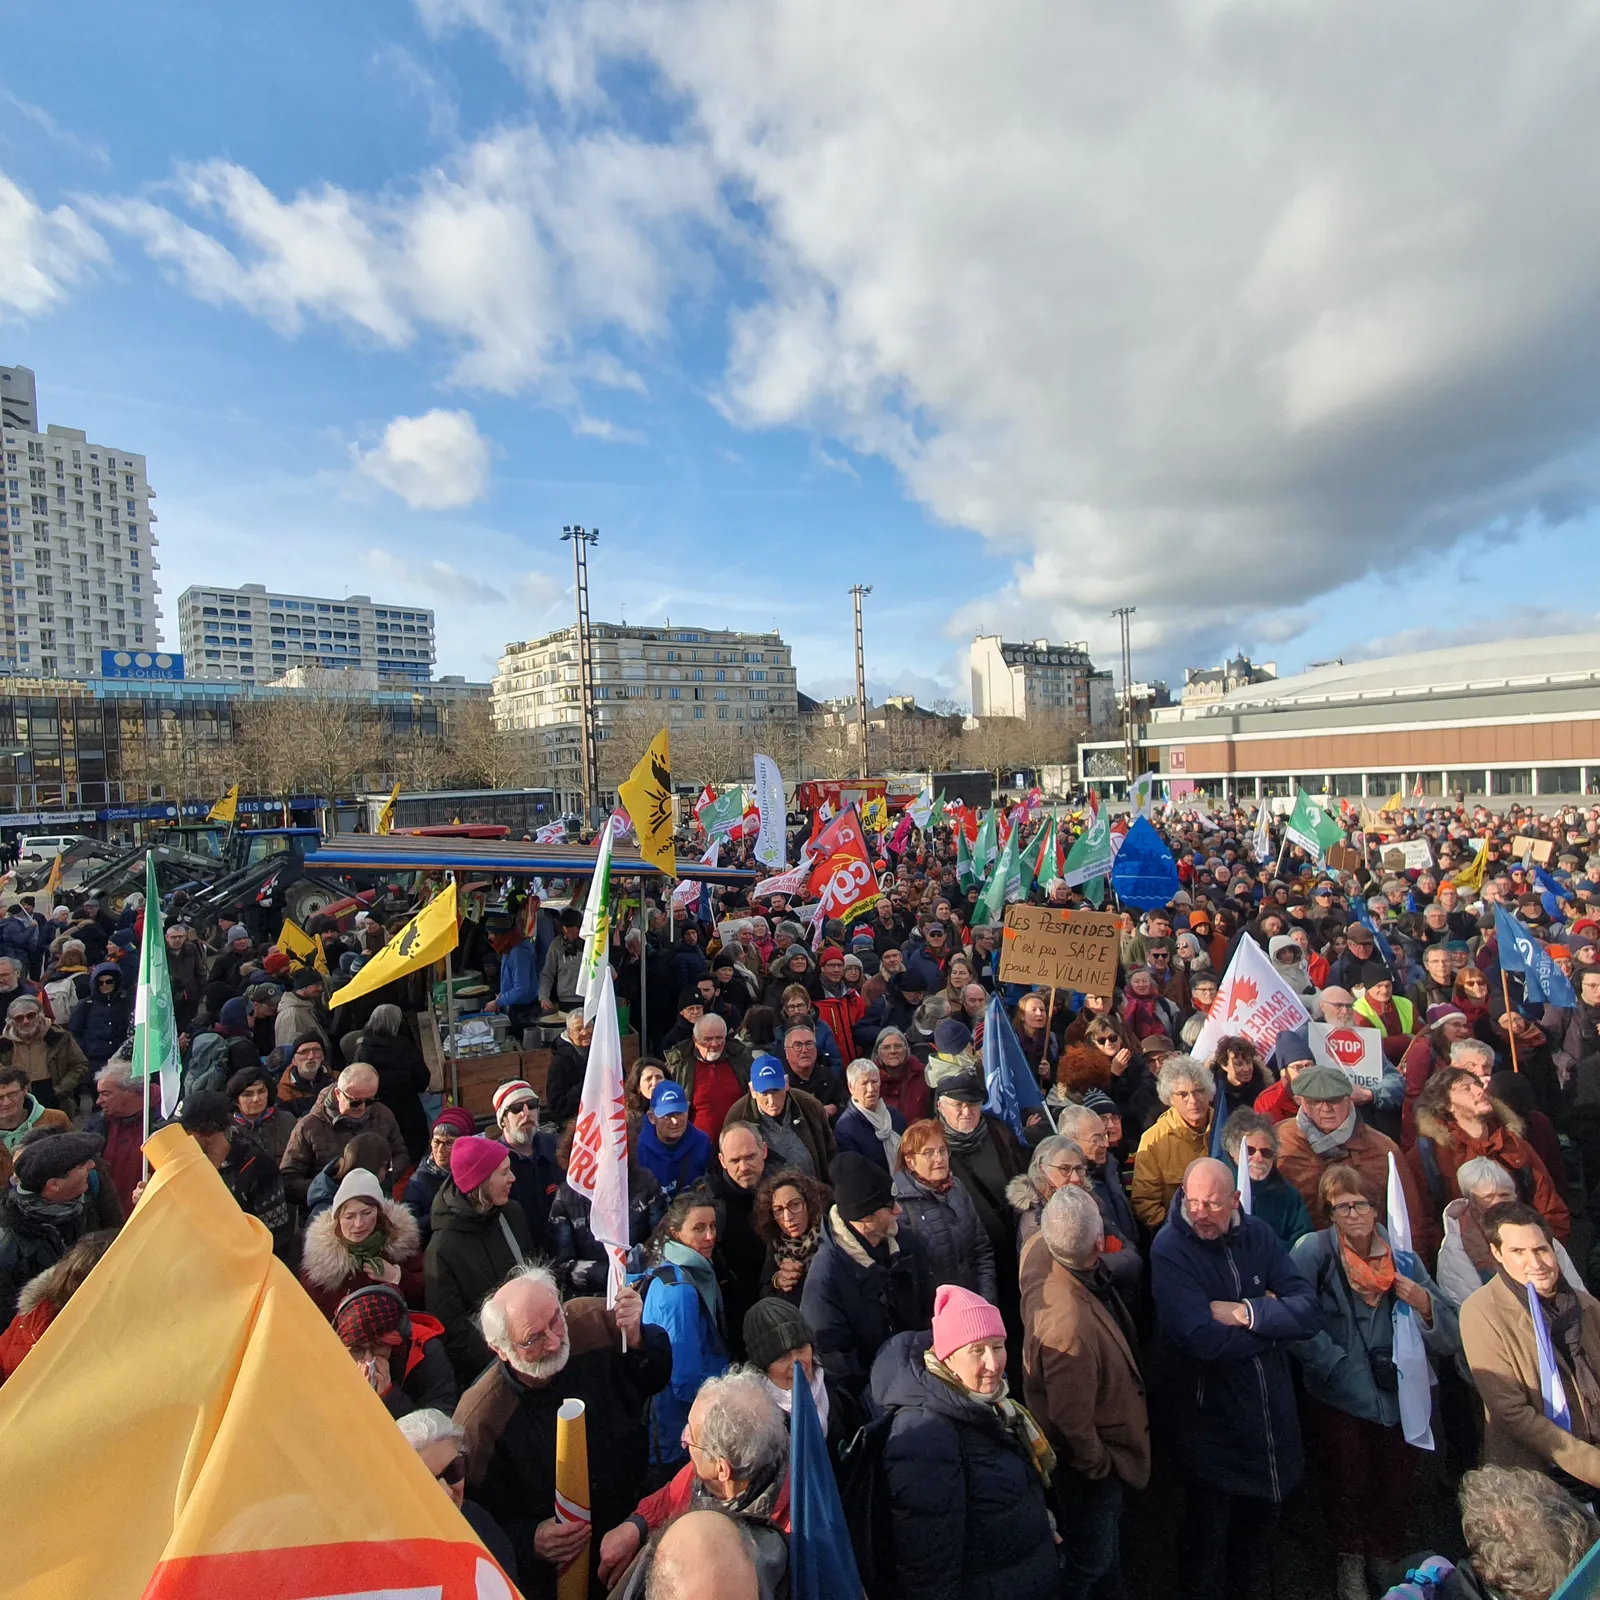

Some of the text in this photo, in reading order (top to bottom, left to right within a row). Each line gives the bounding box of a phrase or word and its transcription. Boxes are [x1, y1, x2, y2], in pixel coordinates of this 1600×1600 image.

[114, 669, 174, 679] 3 SOLEILS
[1007, 910, 1031, 931] LES
[1038, 944, 1057, 959] pas
[1065, 942, 1109, 962] SAGE
[1002, 963, 1032, 979] pour
[1036, 960, 1049, 978] la
[1329, 1039, 1361, 1054] STOP
[1346, 1075, 1379, 1087] CIDES
